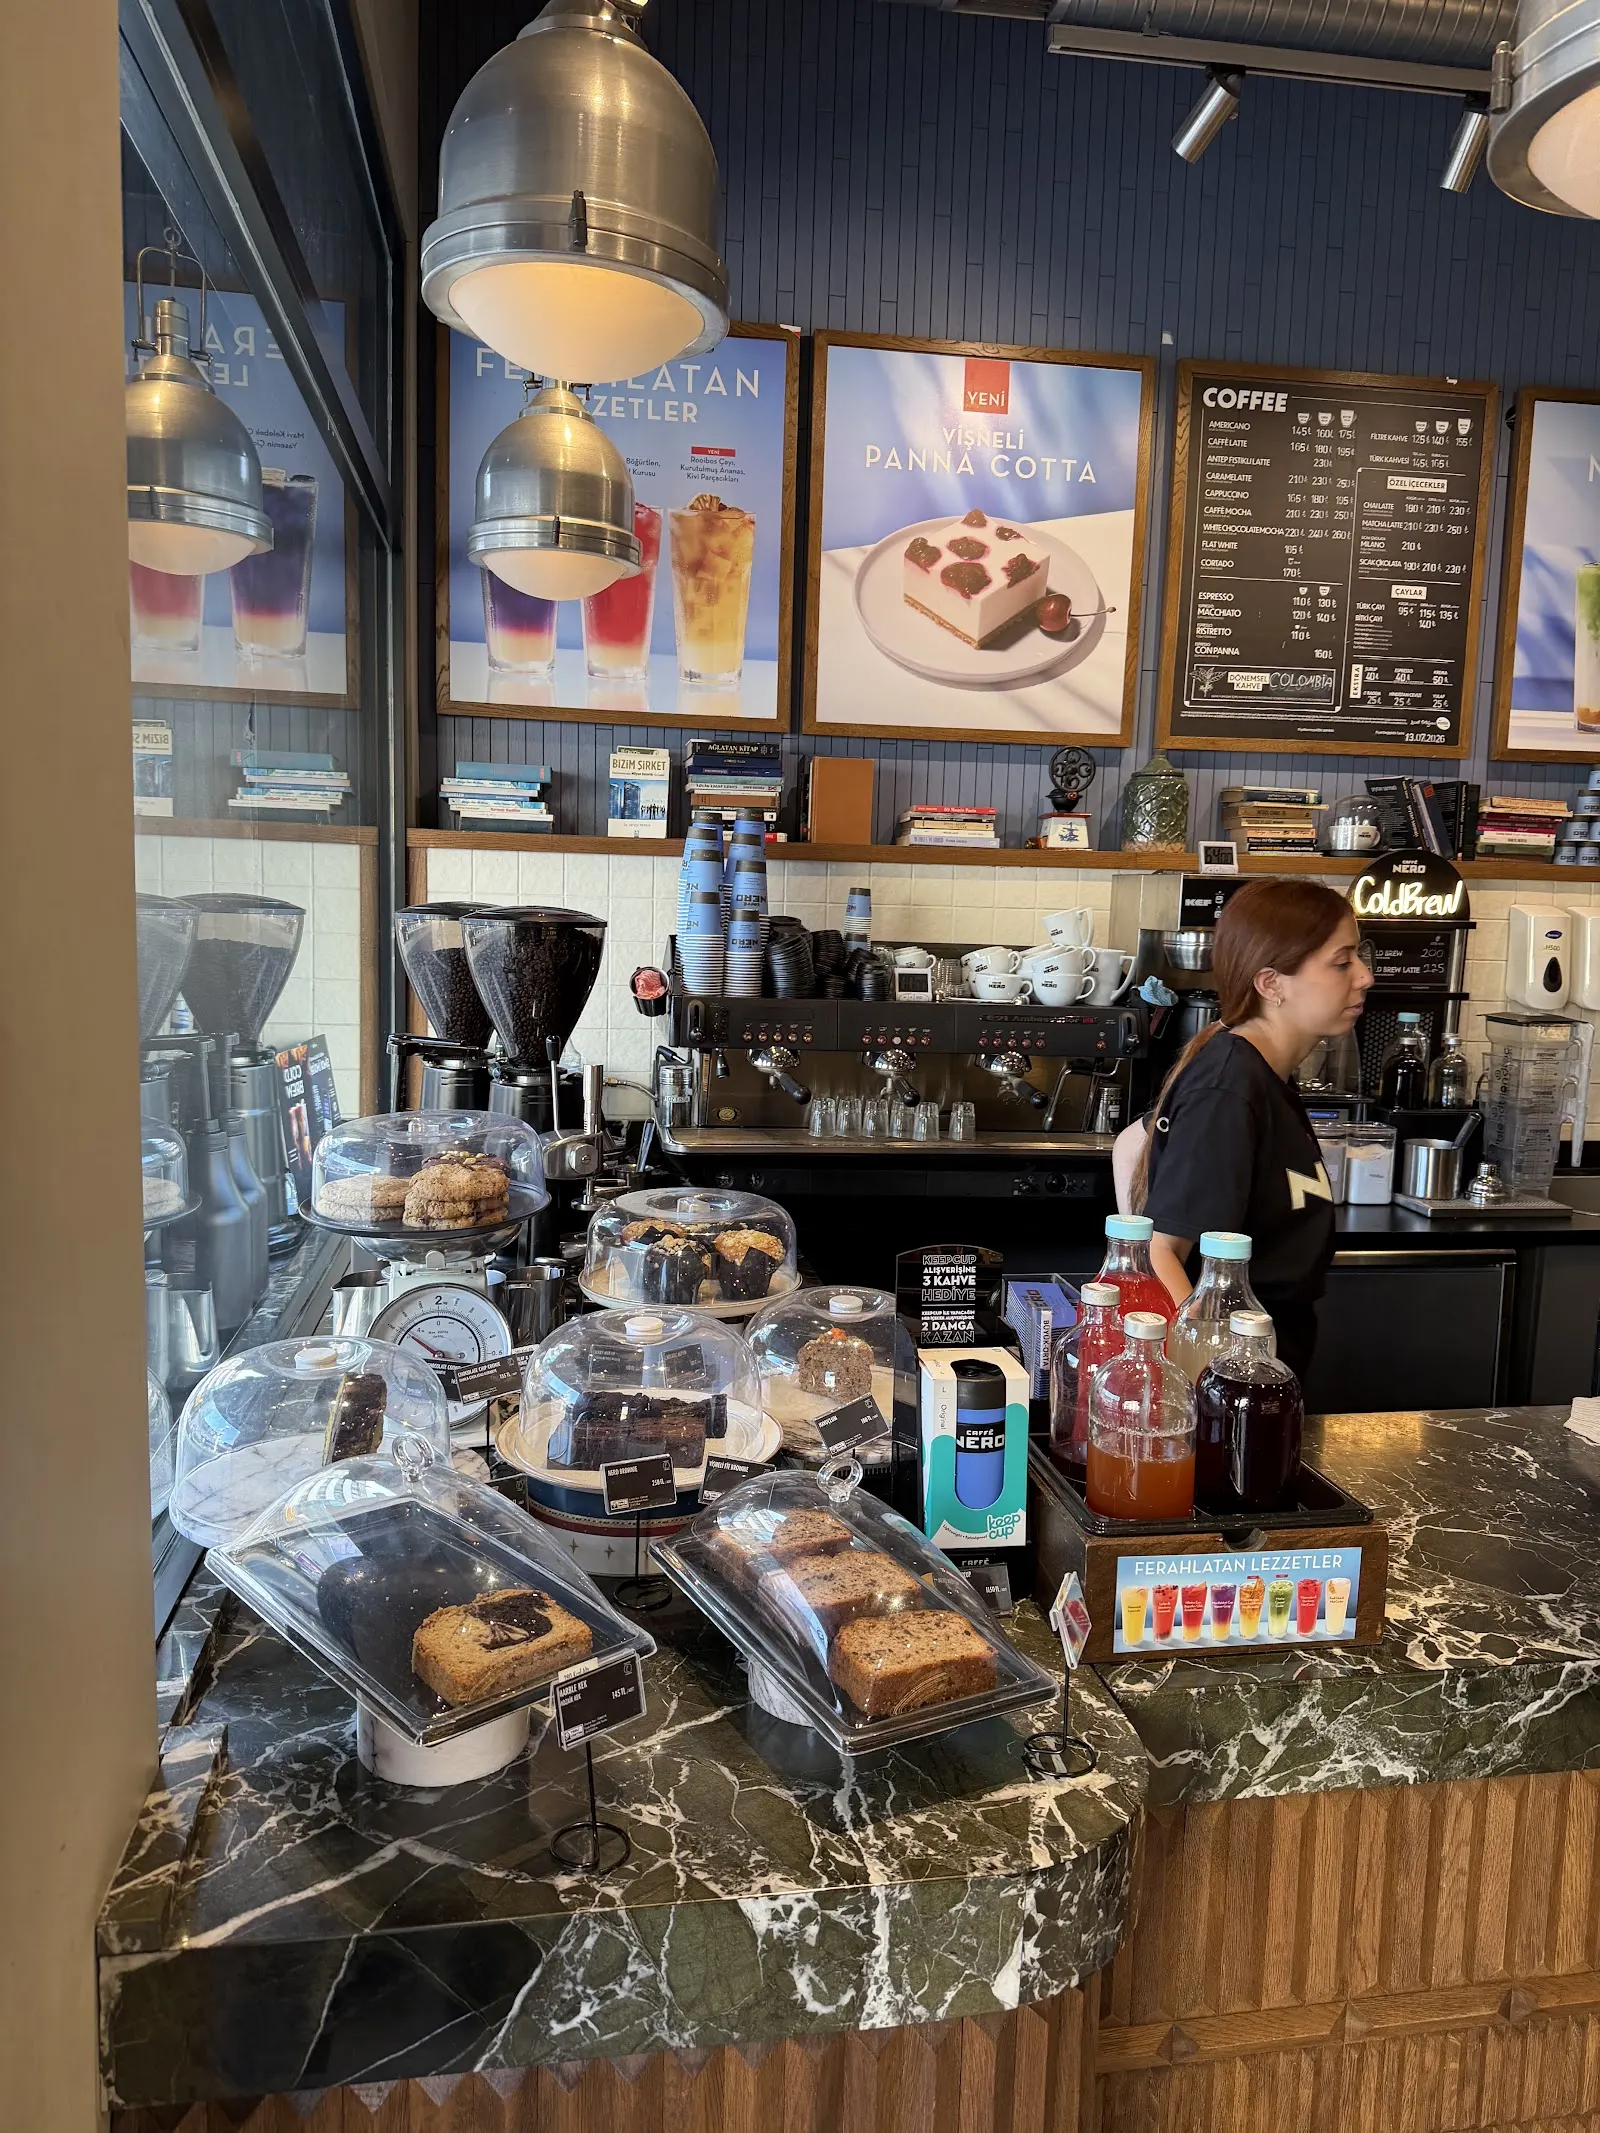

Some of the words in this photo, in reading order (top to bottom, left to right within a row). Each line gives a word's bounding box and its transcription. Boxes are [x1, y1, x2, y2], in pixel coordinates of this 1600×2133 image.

[967, 390, 1005, 407] YENİ
[1203, 387, 1288, 412] COFFEE
[1209, 421, 1250, 430] AMERICANO
[943, 427, 1023, 450] VİŞNELİ
[1208, 437, 1228, 446] CAFFÈ
[1229, 439, 1247, 447] LATTE
[691, 456, 717, 464] Rooibos
[865, 445, 974, 475] PANNA
[991, 455, 1096, 483] COTTA
[1207, 455, 1228, 463] ANTEP
[1252, 458, 1270, 466] LATTE
[1370, 455, 1383, 463] TÜRK
[1384, 456, 1409, 464] KAHVESİ
[633, 469, 655, 477] Kurusu
[680, 464, 718, 475] Kurutulmuş
[700, 474, 739, 483] Parçacıkları
[1206, 472, 1252, 482] CARAMELATTE
[1389, 479, 1408, 487] ÖZEL
[1409, 480, 1445, 489] İÇECEKLER
[1205, 489, 1249, 499] CAPPUCCINO
[1204, 505, 1225, 515] CAFFÈ
[1225, 507, 1252, 516] MOCHA
[1378, 502, 1394, 510] LATTE
[1203, 524, 1222, 532] WHITE
[1260, 527, 1284, 535] MOCHA
[1387, 521, 1403, 529] LATTE
[1218, 541, 1238, 550] WHITE
[1201, 559, 1234, 568] CORTADO
[1199, 592, 1234, 601] ESPRESSO
[1371, 603, 1385, 611] ÇAYI
[1197, 609, 1241, 617] MACCHIATO
[1355, 614, 1370, 622] BİTKİ
[1196, 628, 1232, 636] RISTRETTO
[1194, 646, 1213, 655] CON
[1213, 647, 1240, 655] PANNA
[1230, 674, 1268, 682] DÖNEMSEL
[739, 744, 758, 752] KİTAP
[612, 758, 635, 769] BİZİM
[638, 761, 666, 771] ŞİRKET
[1392, 865, 1426, 873] NERO
[923, 1255, 976, 1266] KEEPCUP
[923, 1265, 976, 1275] ALIŞVERİŞİNE
[923, 1276, 931, 1286] 3
[934, 1275, 976, 1286] KAHVE
[922, 1286, 976, 1301] HEDİYE
[435, 1295, 442, 1305] 2
[922, 1322, 928, 1331] 2
[932, 1321, 974, 1330] DAMGA
[921, 1331, 974, 1343] KAZAN
[966, 1429, 995, 1437] CAFFÈ
[608, 1469, 619, 1477] NERO
[619, 1465, 638, 1475] BROWNIE
[988, 1513, 1021, 1530] keep
[989, 1526, 1014, 1539] cup
[1135, 1558, 1246, 1575] FERAHLATAN
[1251, 1555, 1342, 1571] LEZZETLER
[578, 1680, 588, 1690] KEK
[573, 1693, 581, 1702] KEK
